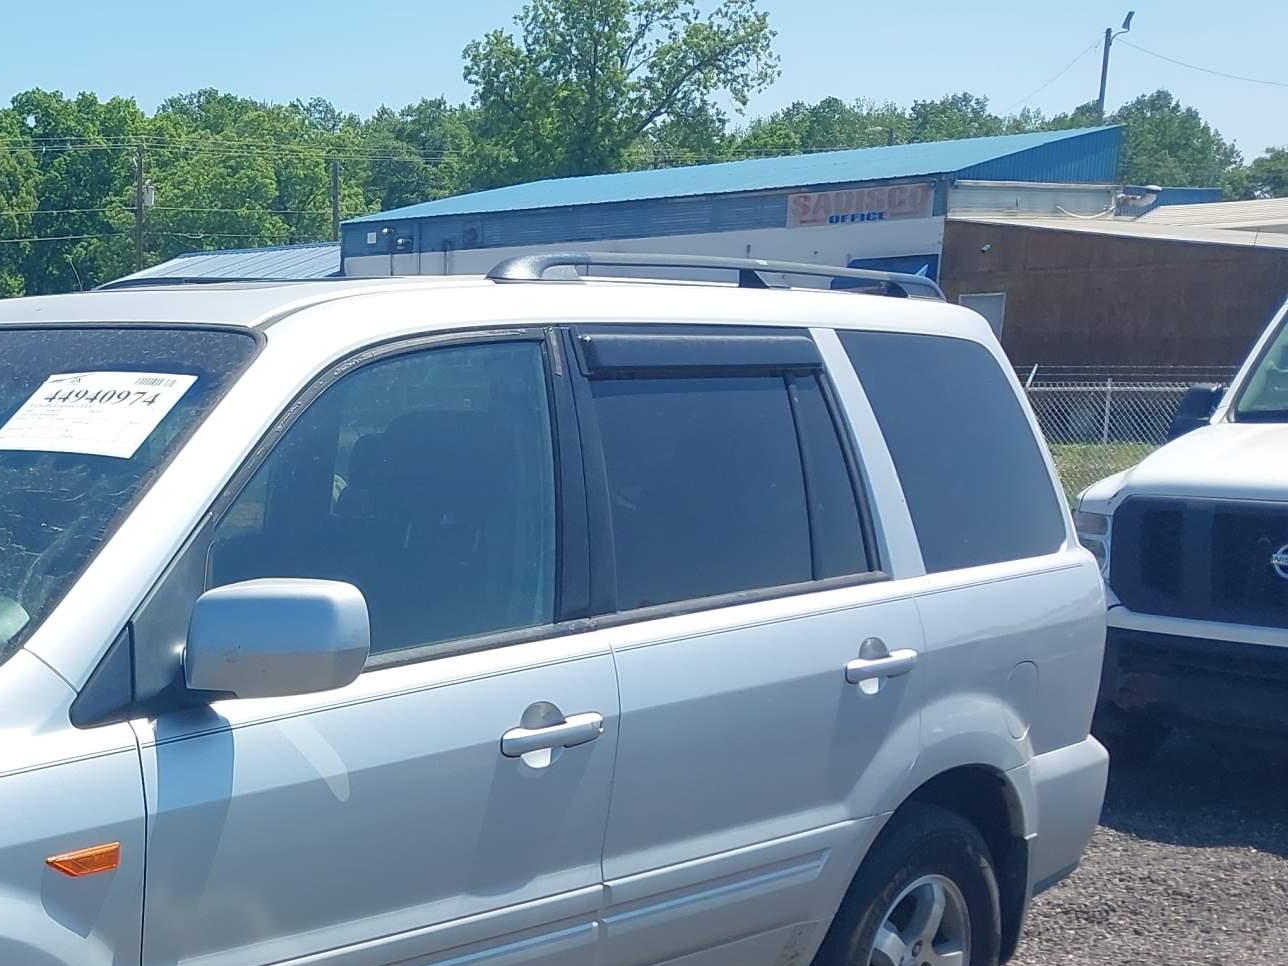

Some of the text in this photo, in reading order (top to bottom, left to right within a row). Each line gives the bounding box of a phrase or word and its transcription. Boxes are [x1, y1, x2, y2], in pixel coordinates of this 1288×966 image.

[792, 186, 929, 215] SADISCO
[829, 211, 886, 224] OFFICE
[45, 389, 161, 406] 44940974
